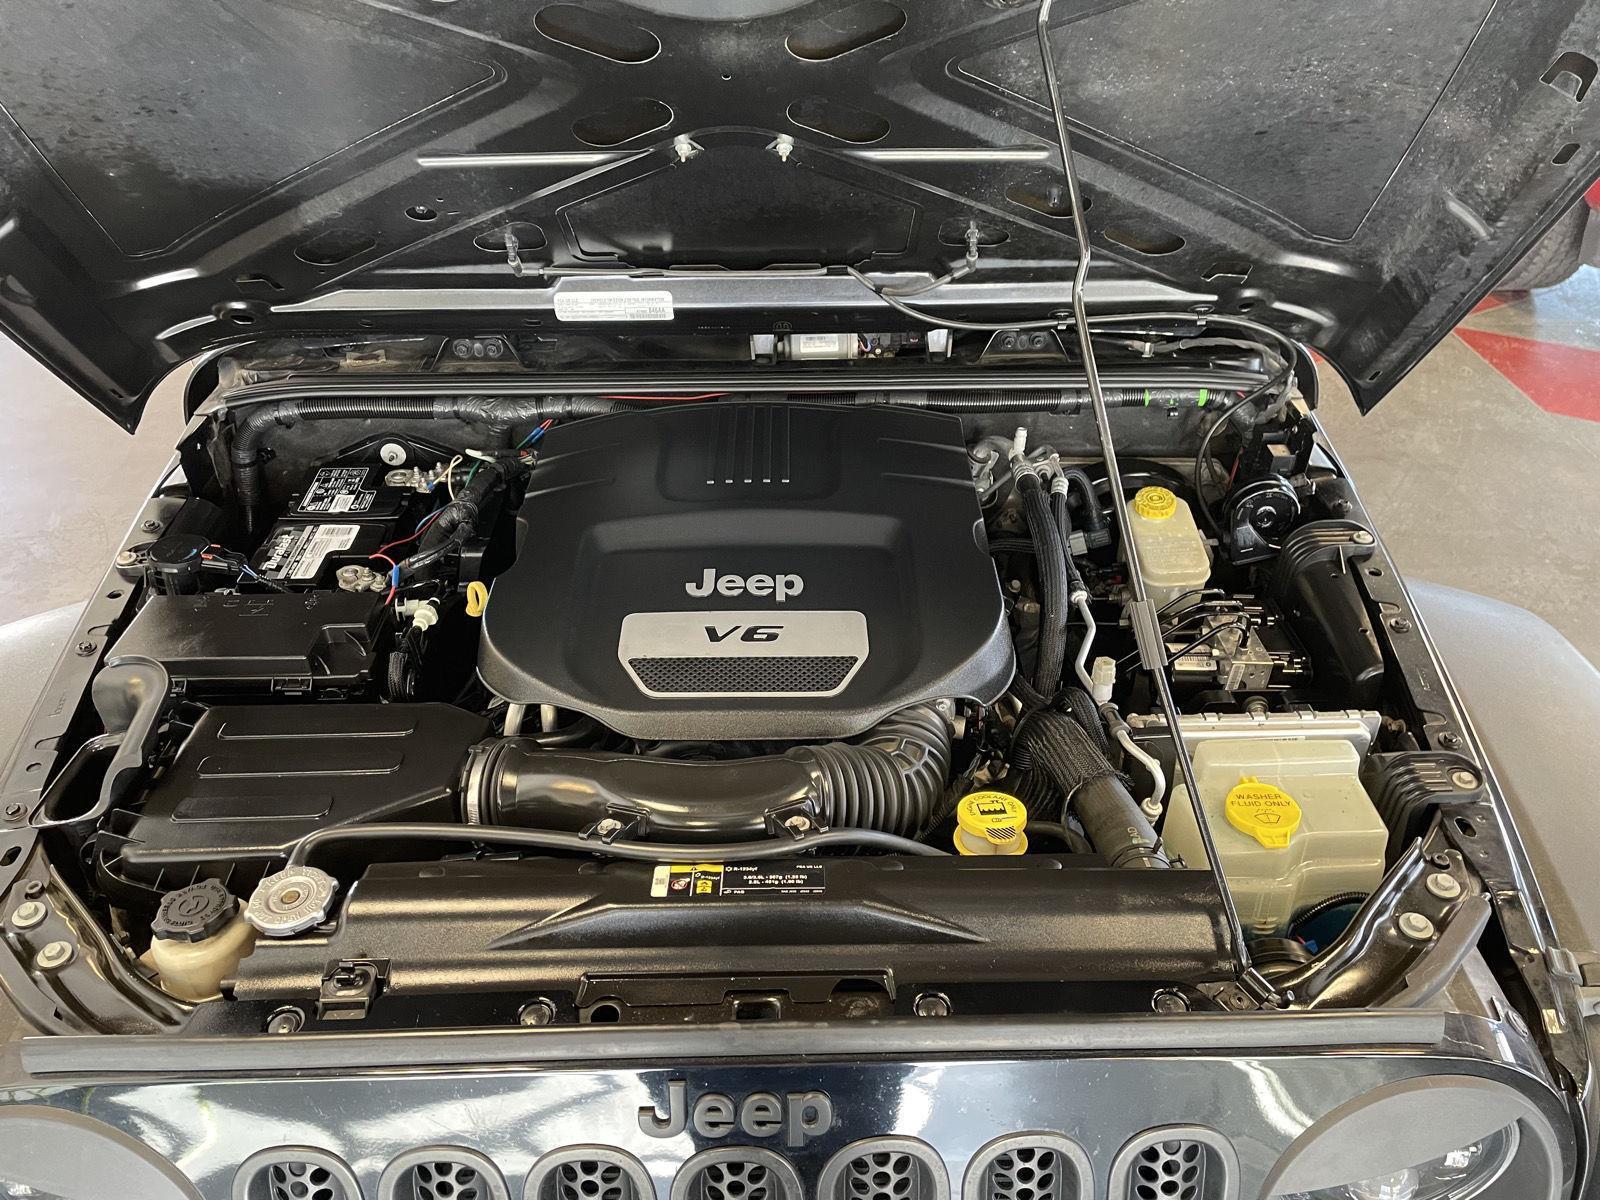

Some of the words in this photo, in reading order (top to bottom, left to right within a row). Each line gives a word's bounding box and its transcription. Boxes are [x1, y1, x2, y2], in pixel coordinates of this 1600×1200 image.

[261, 534, 294, 571] Duralast
[685, 568, 804, 603] Jeep
[704, 625, 784, 643] V6
[974, 794, 1008, 802] COOLANT
[637, 1079, 833, 1147] Jeep
